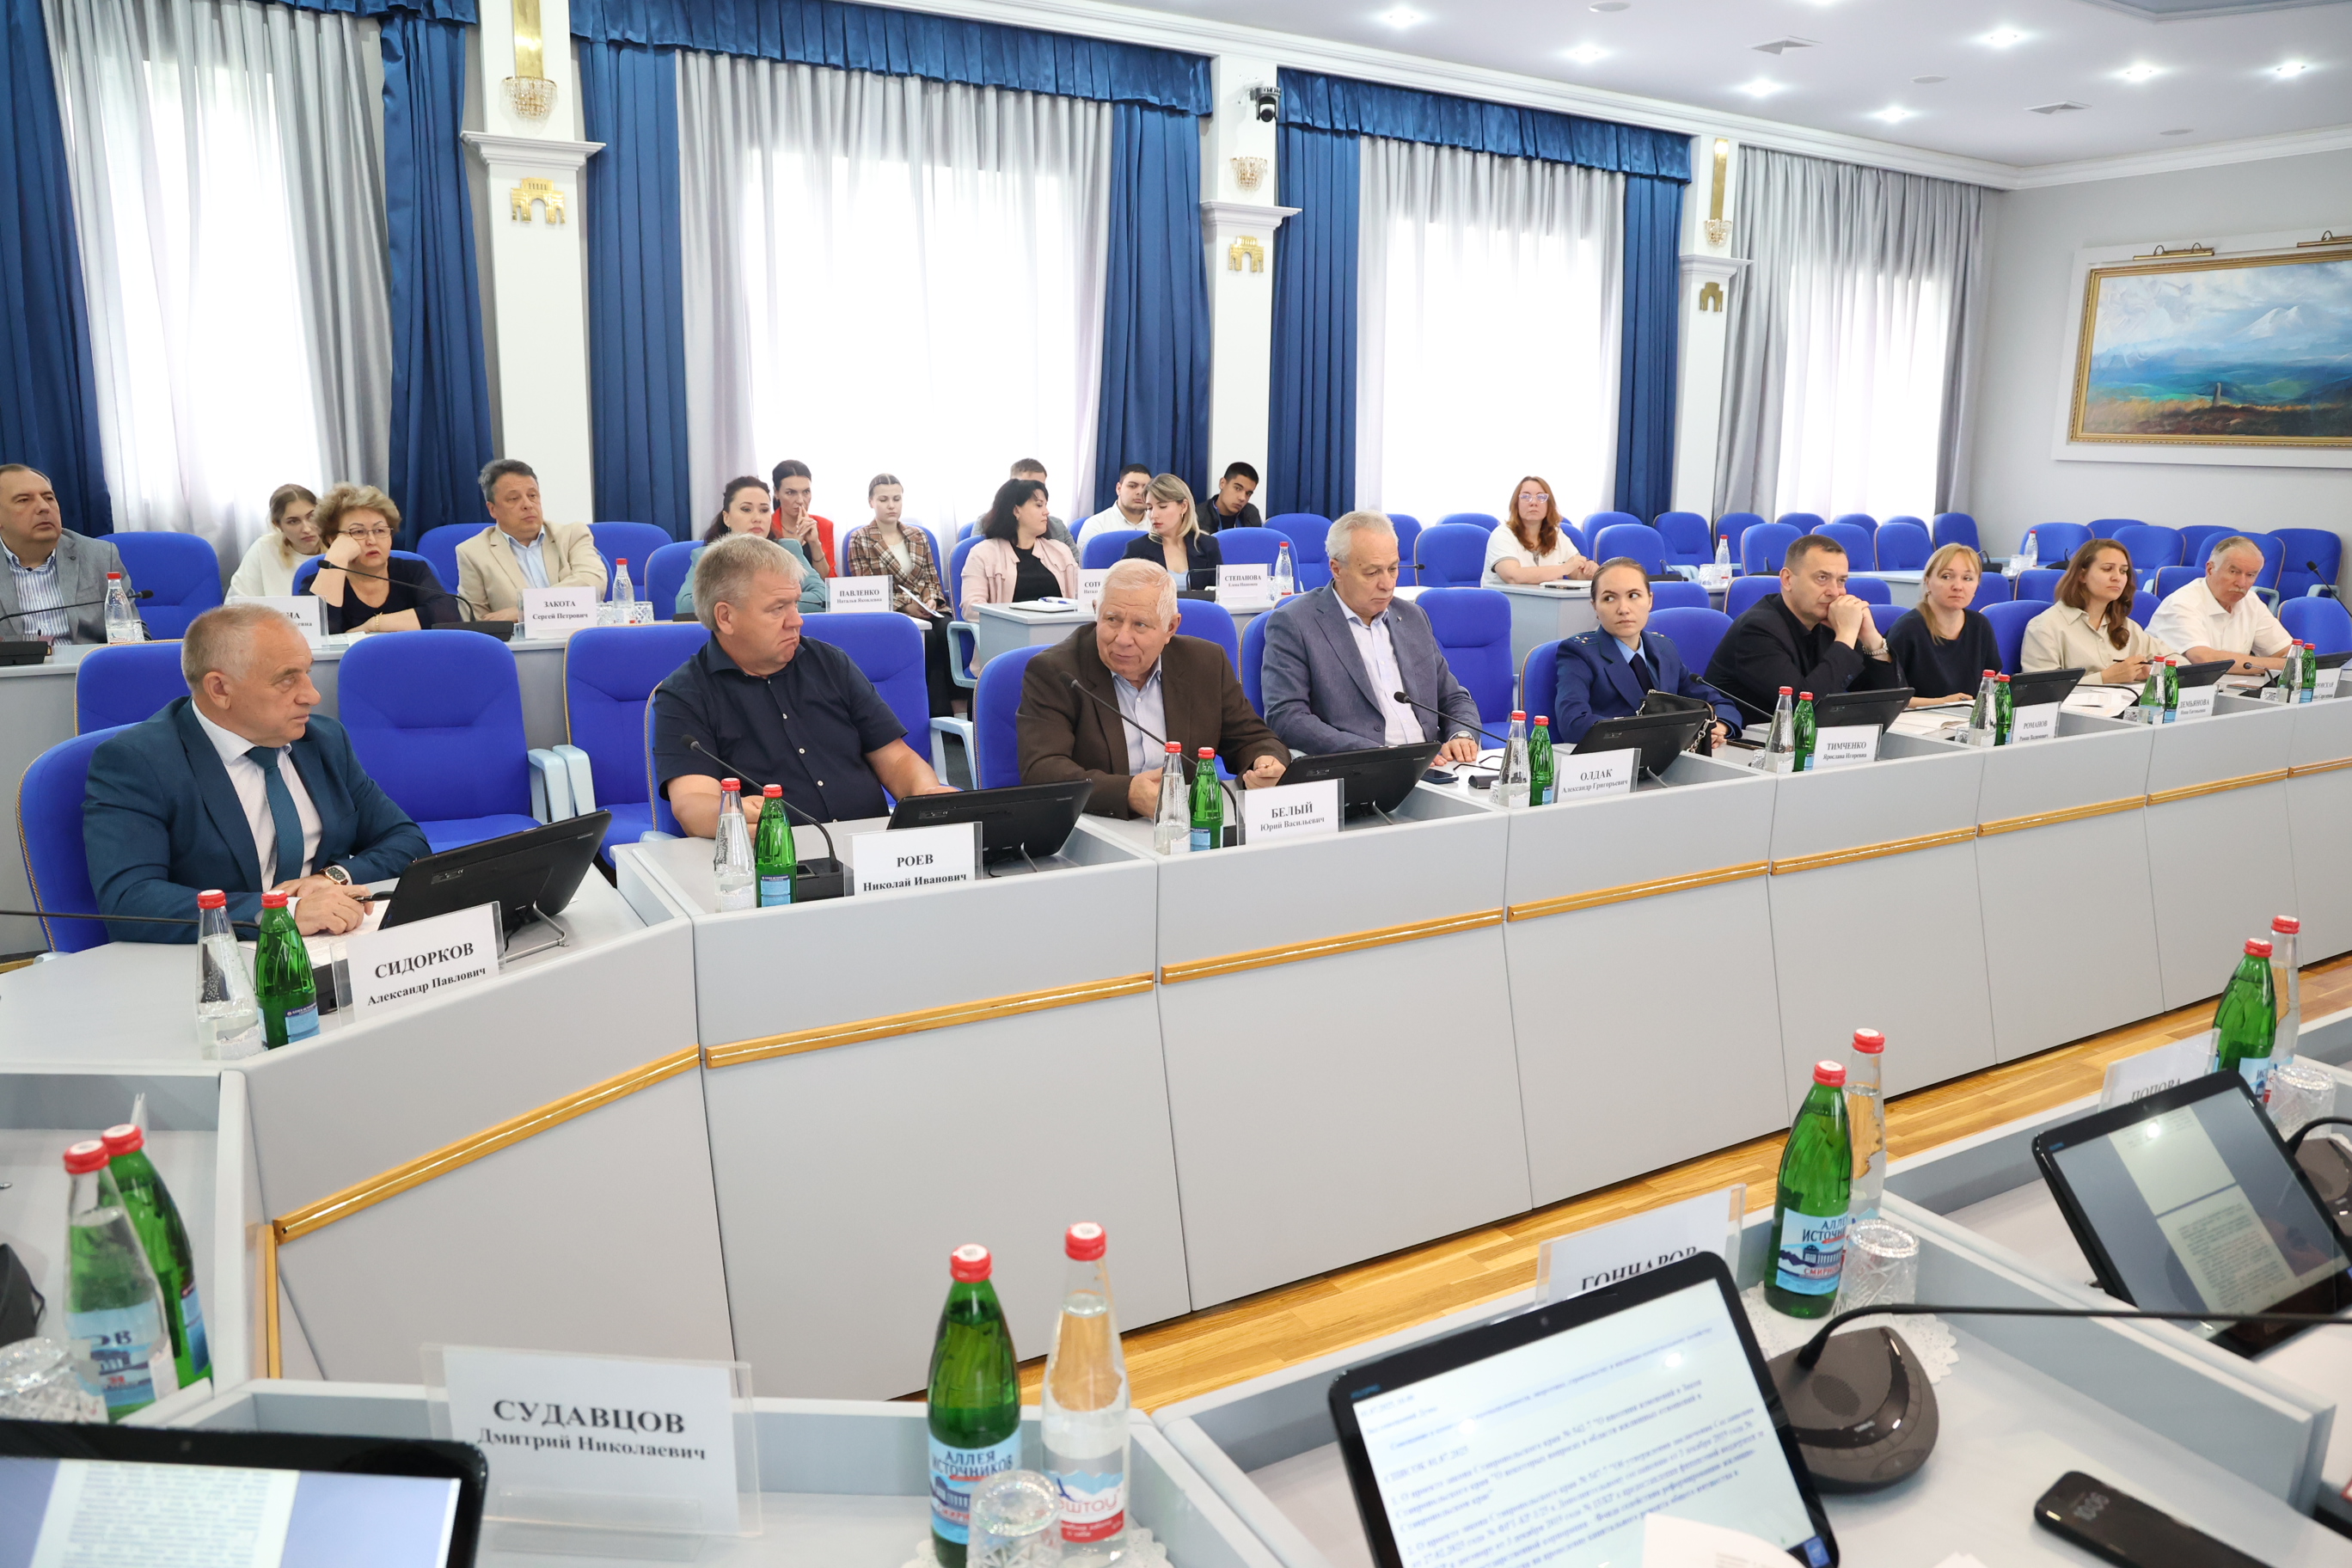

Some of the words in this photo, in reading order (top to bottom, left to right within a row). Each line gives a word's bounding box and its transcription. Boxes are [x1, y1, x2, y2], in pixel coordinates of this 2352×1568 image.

[2178, 699, 2209, 708] ДЕМЬЯНОВА
[2024, 720, 2048, 730] РОМАНОВ
[1827, 741, 1866, 750] ТИМЧЕНКО
[1580, 769, 1613, 781] ОЛДАК
[1562, 784, 1591, 793] Александр
[1593, 780, 1628, 791] Григорьевич
[1271, 801, 1313, 818] БЕЛЫЙ
[1260, 821, 1282, 832] Юрий
[1284, 817, 1325, 828] Васильевич
[897, 854, 934, 867] РОЕВ
[863, 878, 911, 891] Николай
[914, 873, 967, 886] Иванович
[375, 942, 475, 978] СИДОРКОВ
[367, 982, 429, 1006] Александр
[432, 967, 486, 989] Павлович
[493, 1399, 685, 1434] СУДАВЦОВ
[476, 1427, 572, 1451] Дмитрий
[578, 1436, 707, 1461] Николаевич
[946, 1450, 995, 1466] АЛЛЕЯ
